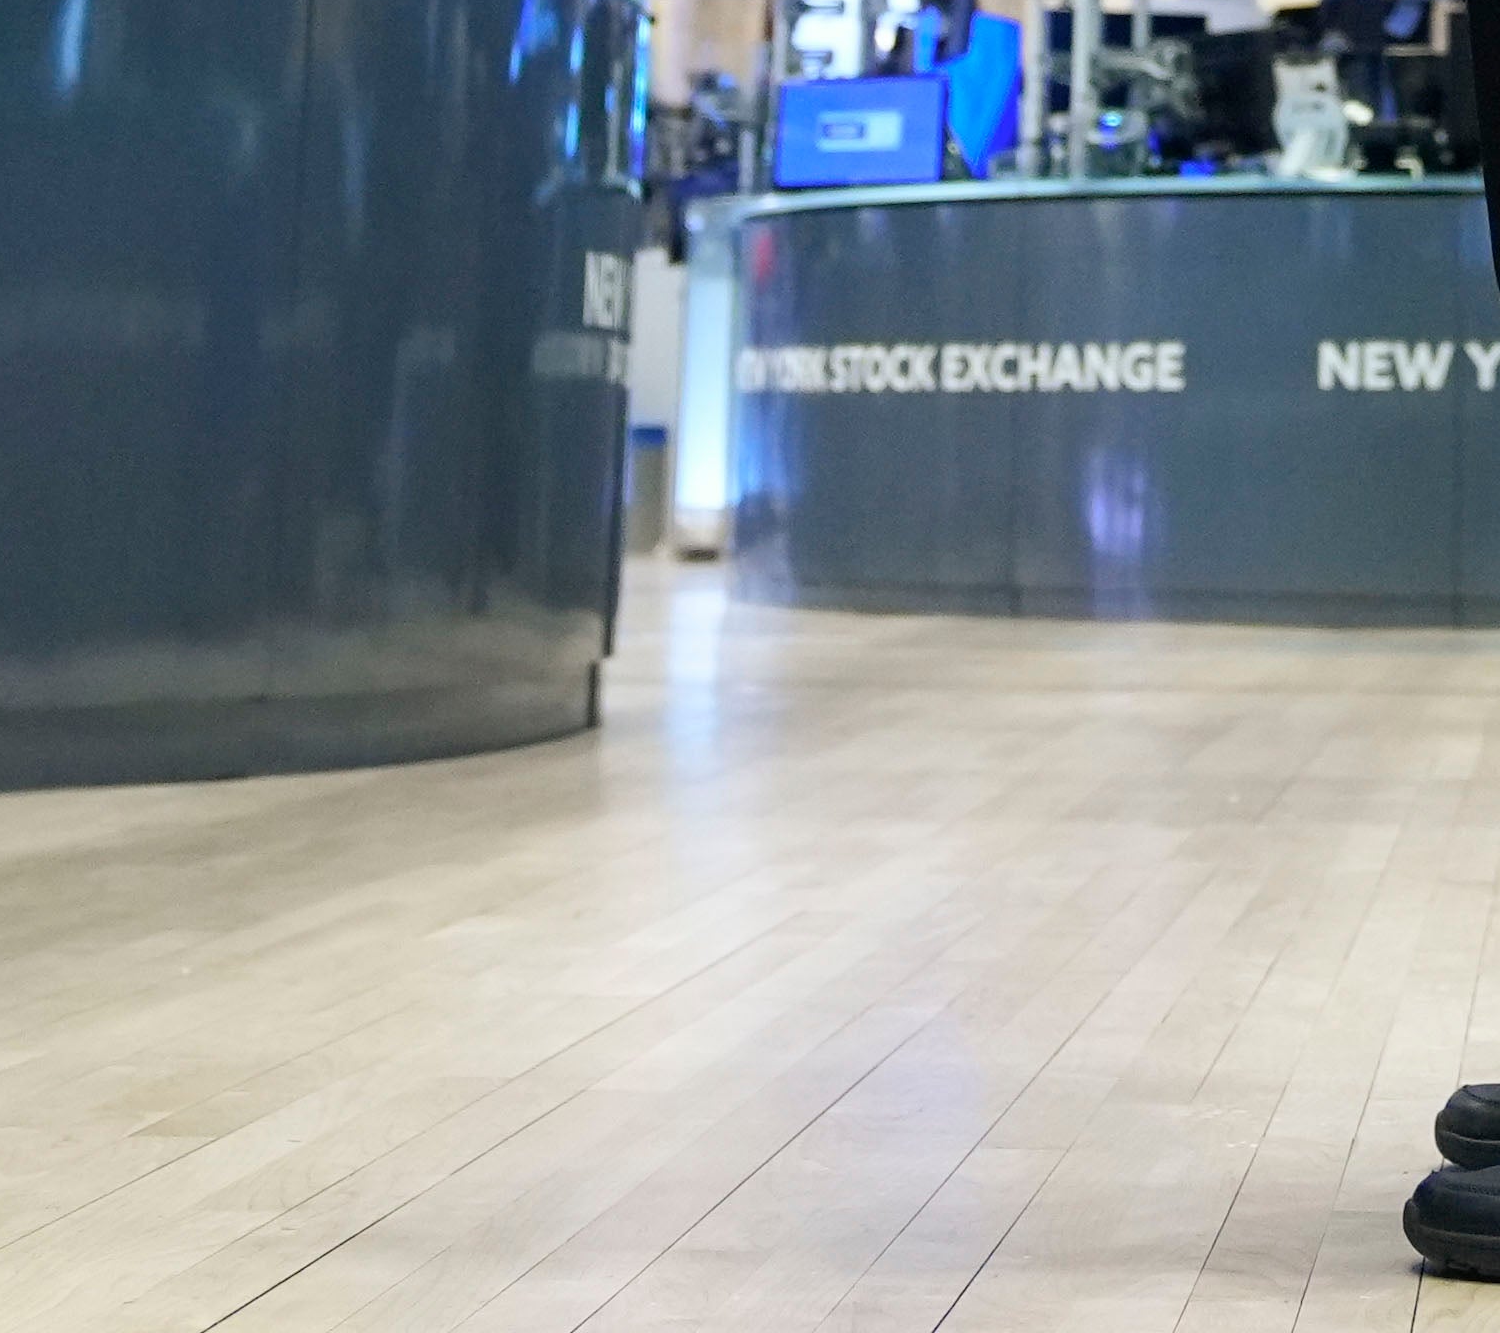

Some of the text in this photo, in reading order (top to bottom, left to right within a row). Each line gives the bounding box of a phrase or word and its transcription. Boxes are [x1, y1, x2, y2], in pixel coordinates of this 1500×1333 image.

[583, 251, 627, 332] NE
[828, 345, 938, 393] STOCK
[940, 342, 1187, 393] EXCHANGE
[1315, 341, 1457, 391] NEW
